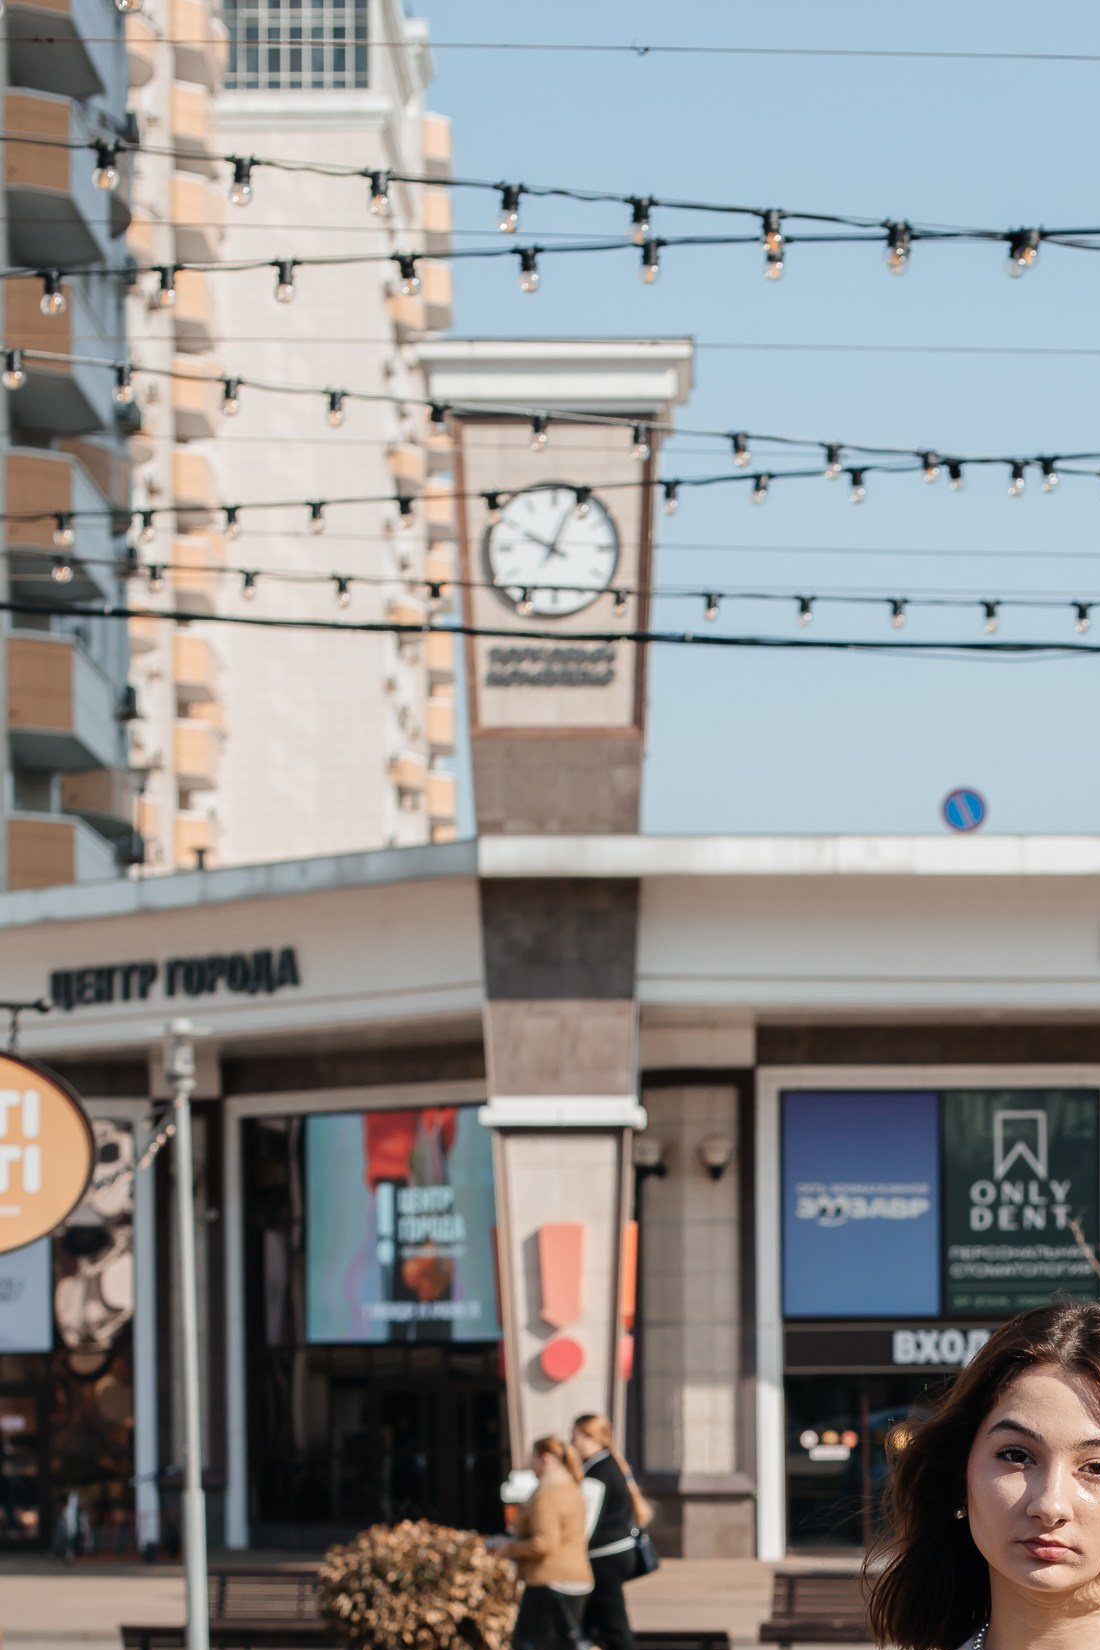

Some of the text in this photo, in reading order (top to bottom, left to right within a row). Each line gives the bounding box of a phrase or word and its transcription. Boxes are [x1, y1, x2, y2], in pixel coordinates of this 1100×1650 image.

[50, 945, 301, 1012] ЦЕНТР ГОРОДА
[969, 1179, 1072, 1207] ONLY
[969, 1205, 1072, 1231] DENT
